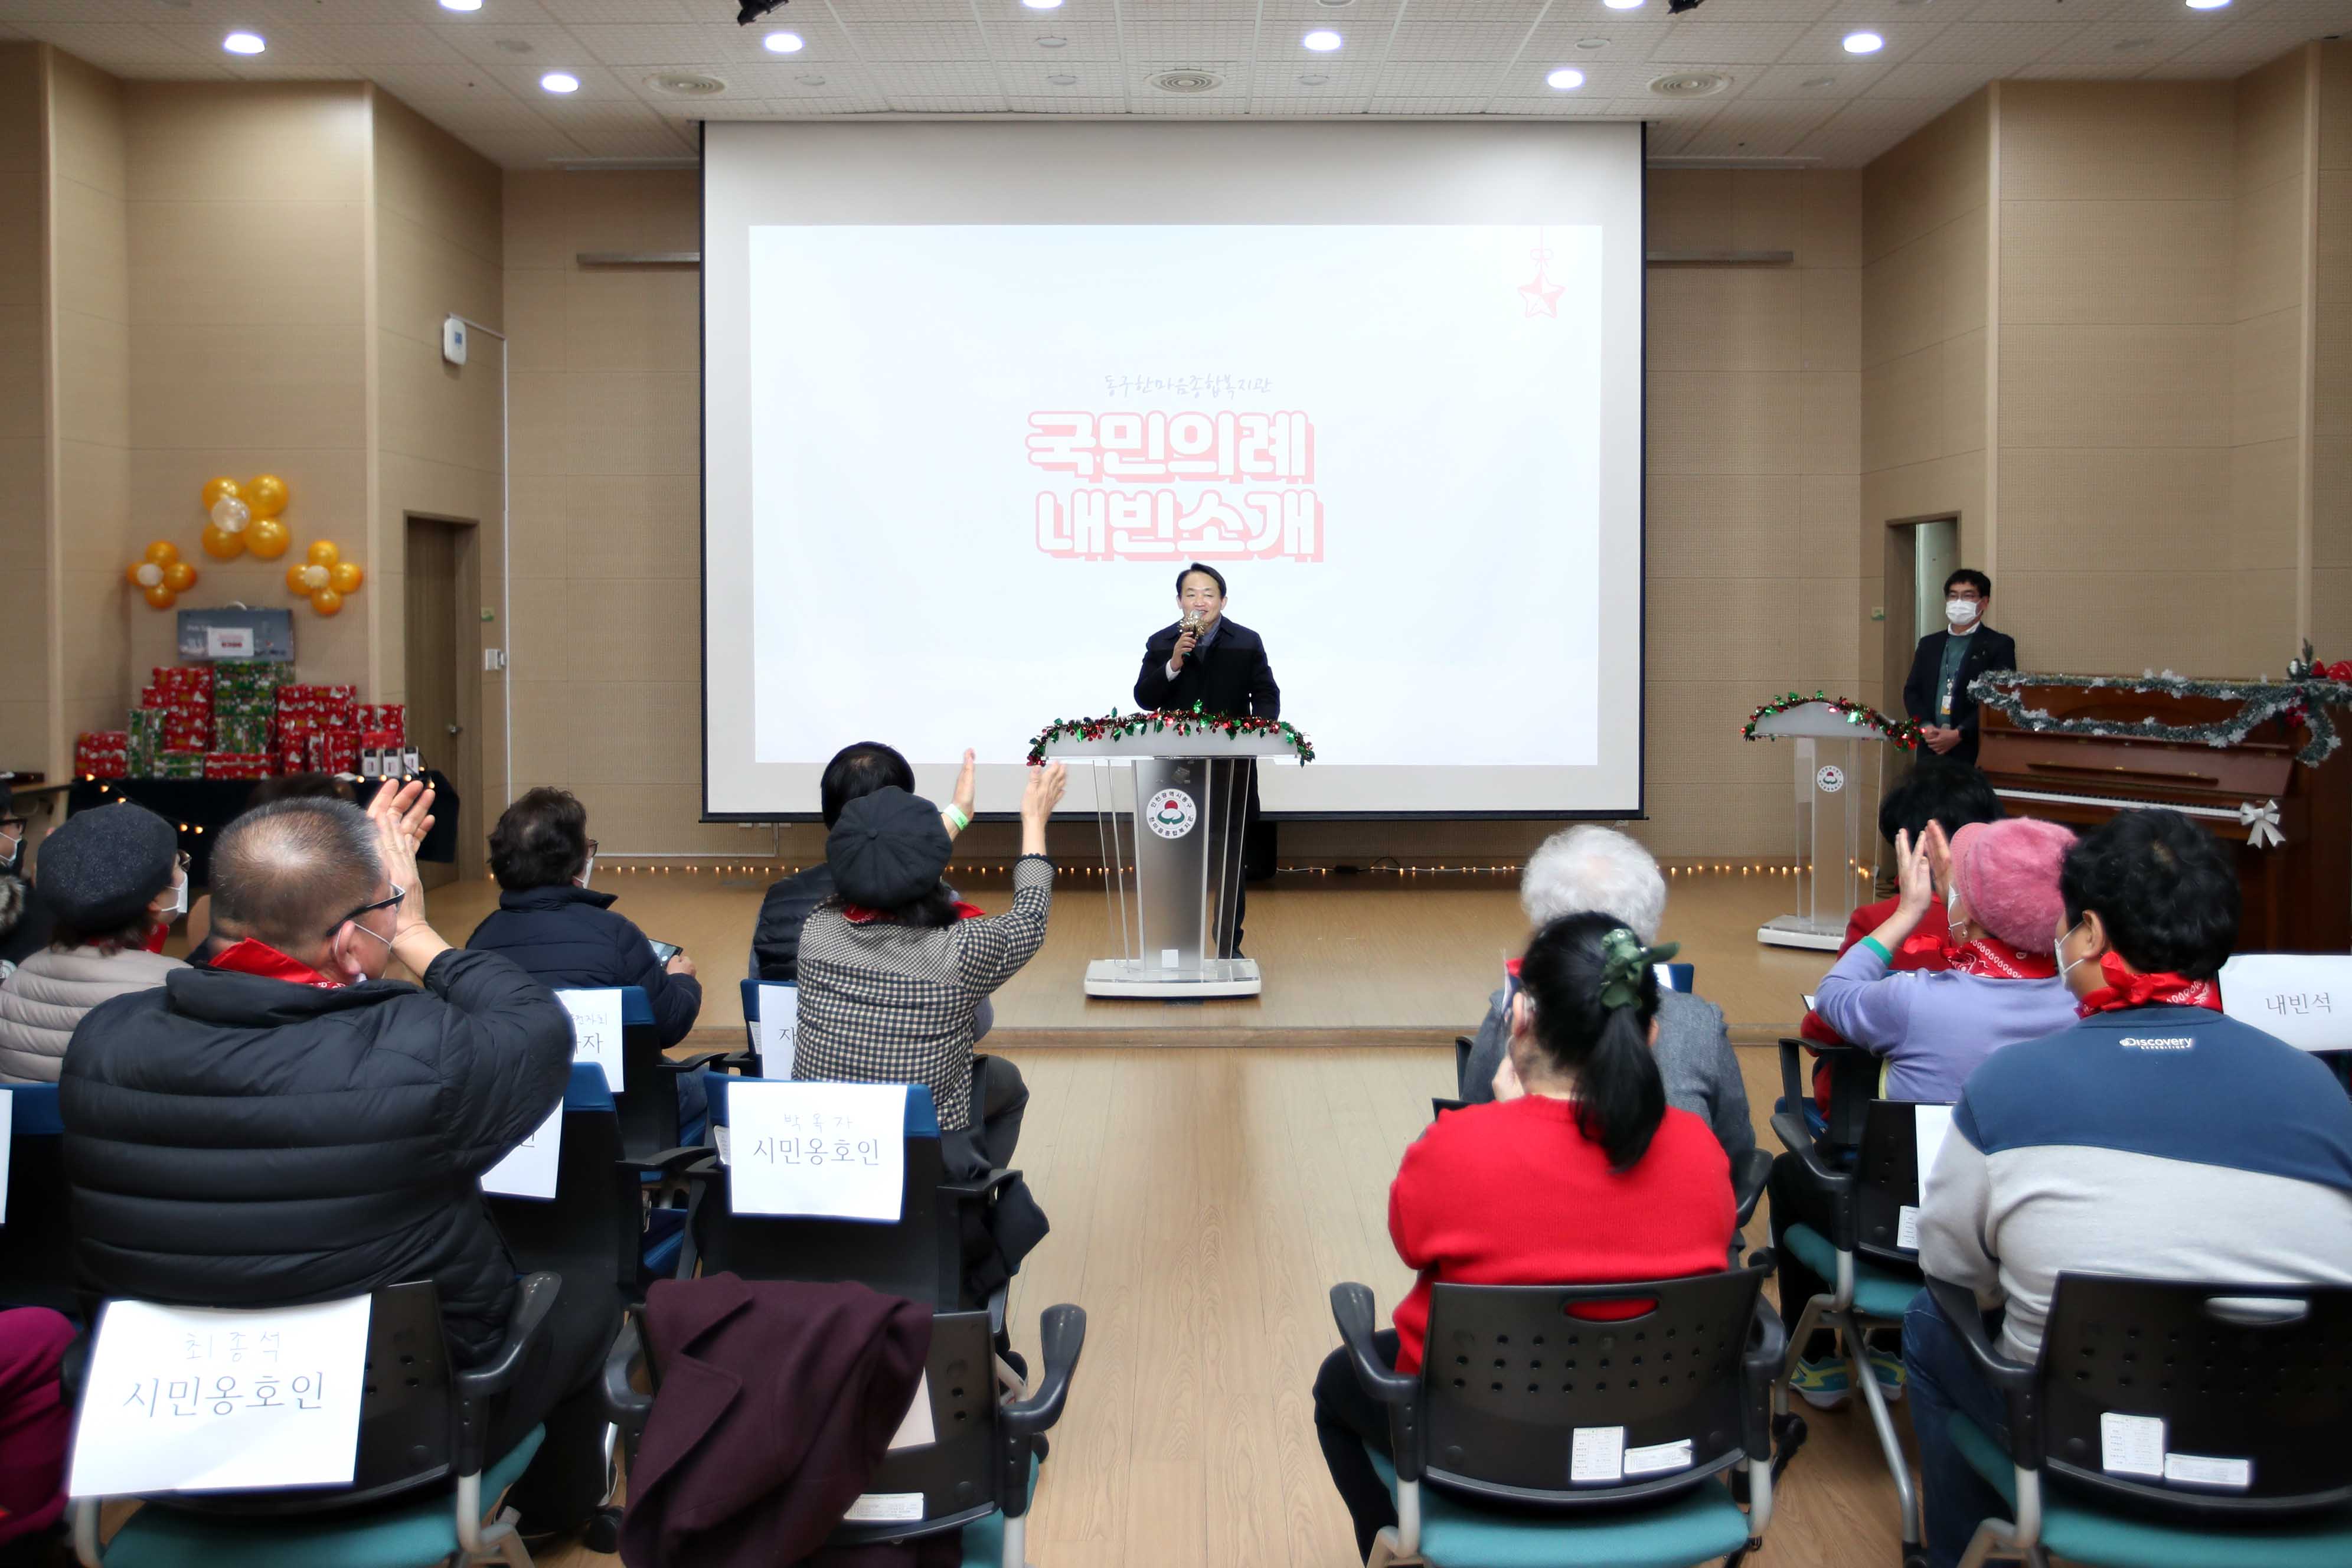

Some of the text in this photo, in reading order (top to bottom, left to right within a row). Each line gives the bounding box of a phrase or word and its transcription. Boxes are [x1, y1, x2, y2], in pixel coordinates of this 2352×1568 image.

[1025, 410, 1315, 484] 국민의례
[1035, 488, 1324, 562] 내빈소개
[2266, 992, 2332, 1015] 내빈석
[753, 1136, 880, 1167] 시민옹호인
[122, 1370, 324, 1418] 시민옹호인
